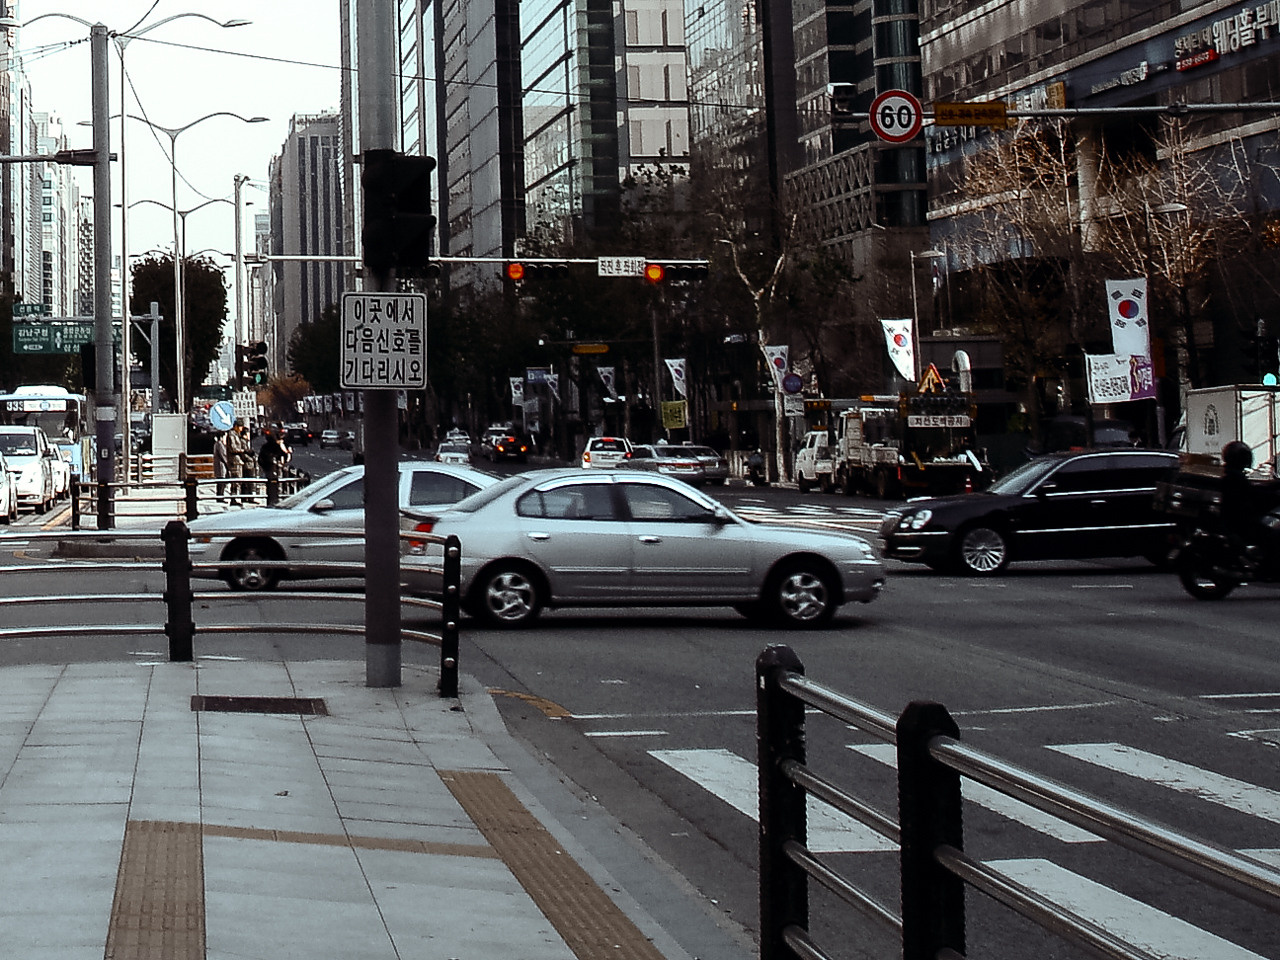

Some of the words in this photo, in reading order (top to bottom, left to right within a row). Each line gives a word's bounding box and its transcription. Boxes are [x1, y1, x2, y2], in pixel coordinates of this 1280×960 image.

[880, 105, 912, 129] 60
[354, 297, 414, 324] 이곳에서
[346, 327, 422, 355] 다음신호를
[345, 357, 422, 384] 기다리시오
